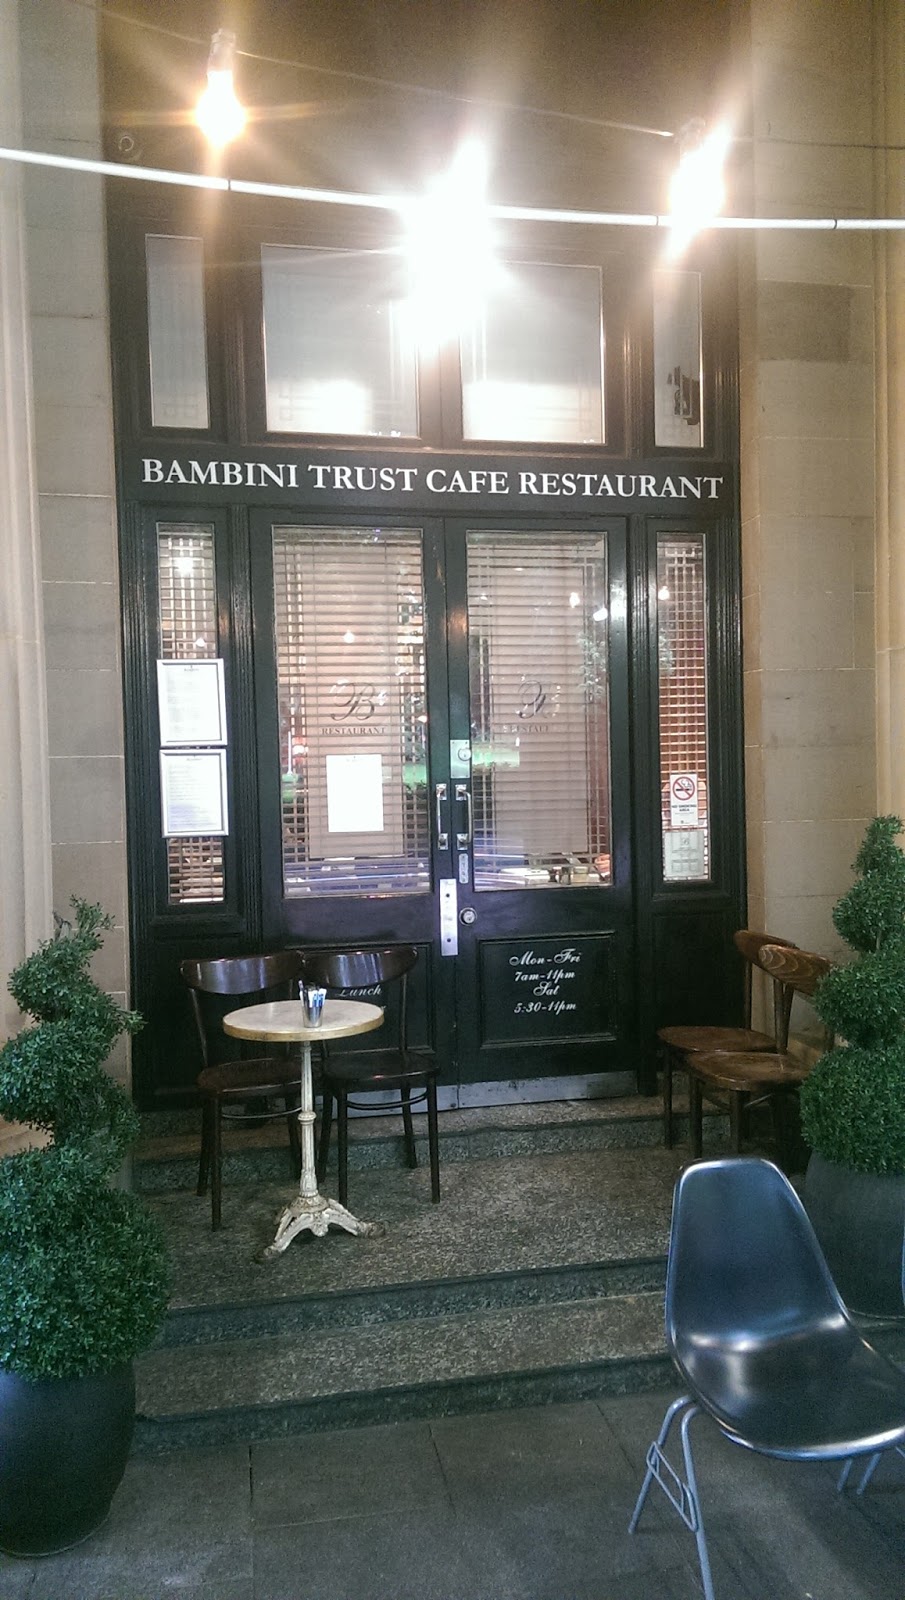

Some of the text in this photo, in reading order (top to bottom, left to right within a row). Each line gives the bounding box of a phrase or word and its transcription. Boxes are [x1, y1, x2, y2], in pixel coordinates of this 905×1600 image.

[142, 458, 724, 500] BAMBINI TRUST CAFE RESTAURANT
[321, 727, 386, 736] RESTAURANT
[337, 984, 383, 998] Lunch
[532, 981, 560, 997] Sat
